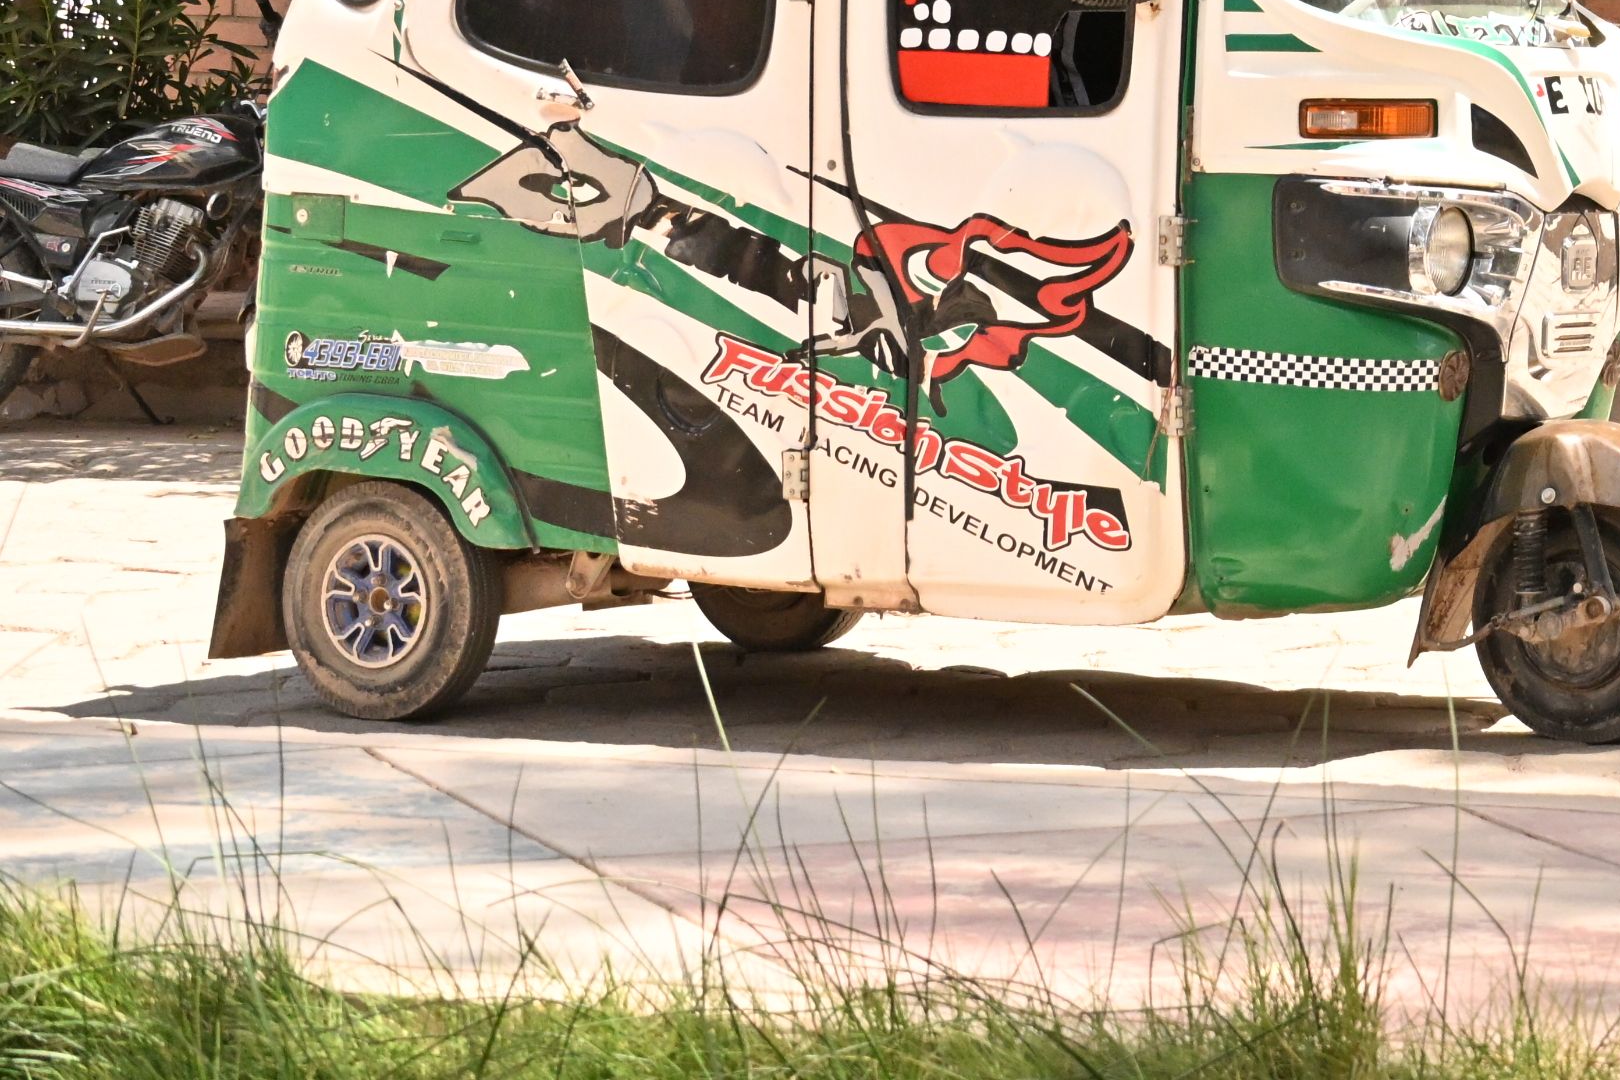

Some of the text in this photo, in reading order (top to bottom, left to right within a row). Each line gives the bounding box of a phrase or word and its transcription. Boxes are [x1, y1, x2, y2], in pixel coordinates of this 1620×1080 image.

[170, 124, 223, 144] TRUENO
[287, 367, 337, 381] TORITO
[716, 384, 785, 433] TEAM
[914, 486, 1114, 595] DEVELOPMENT
